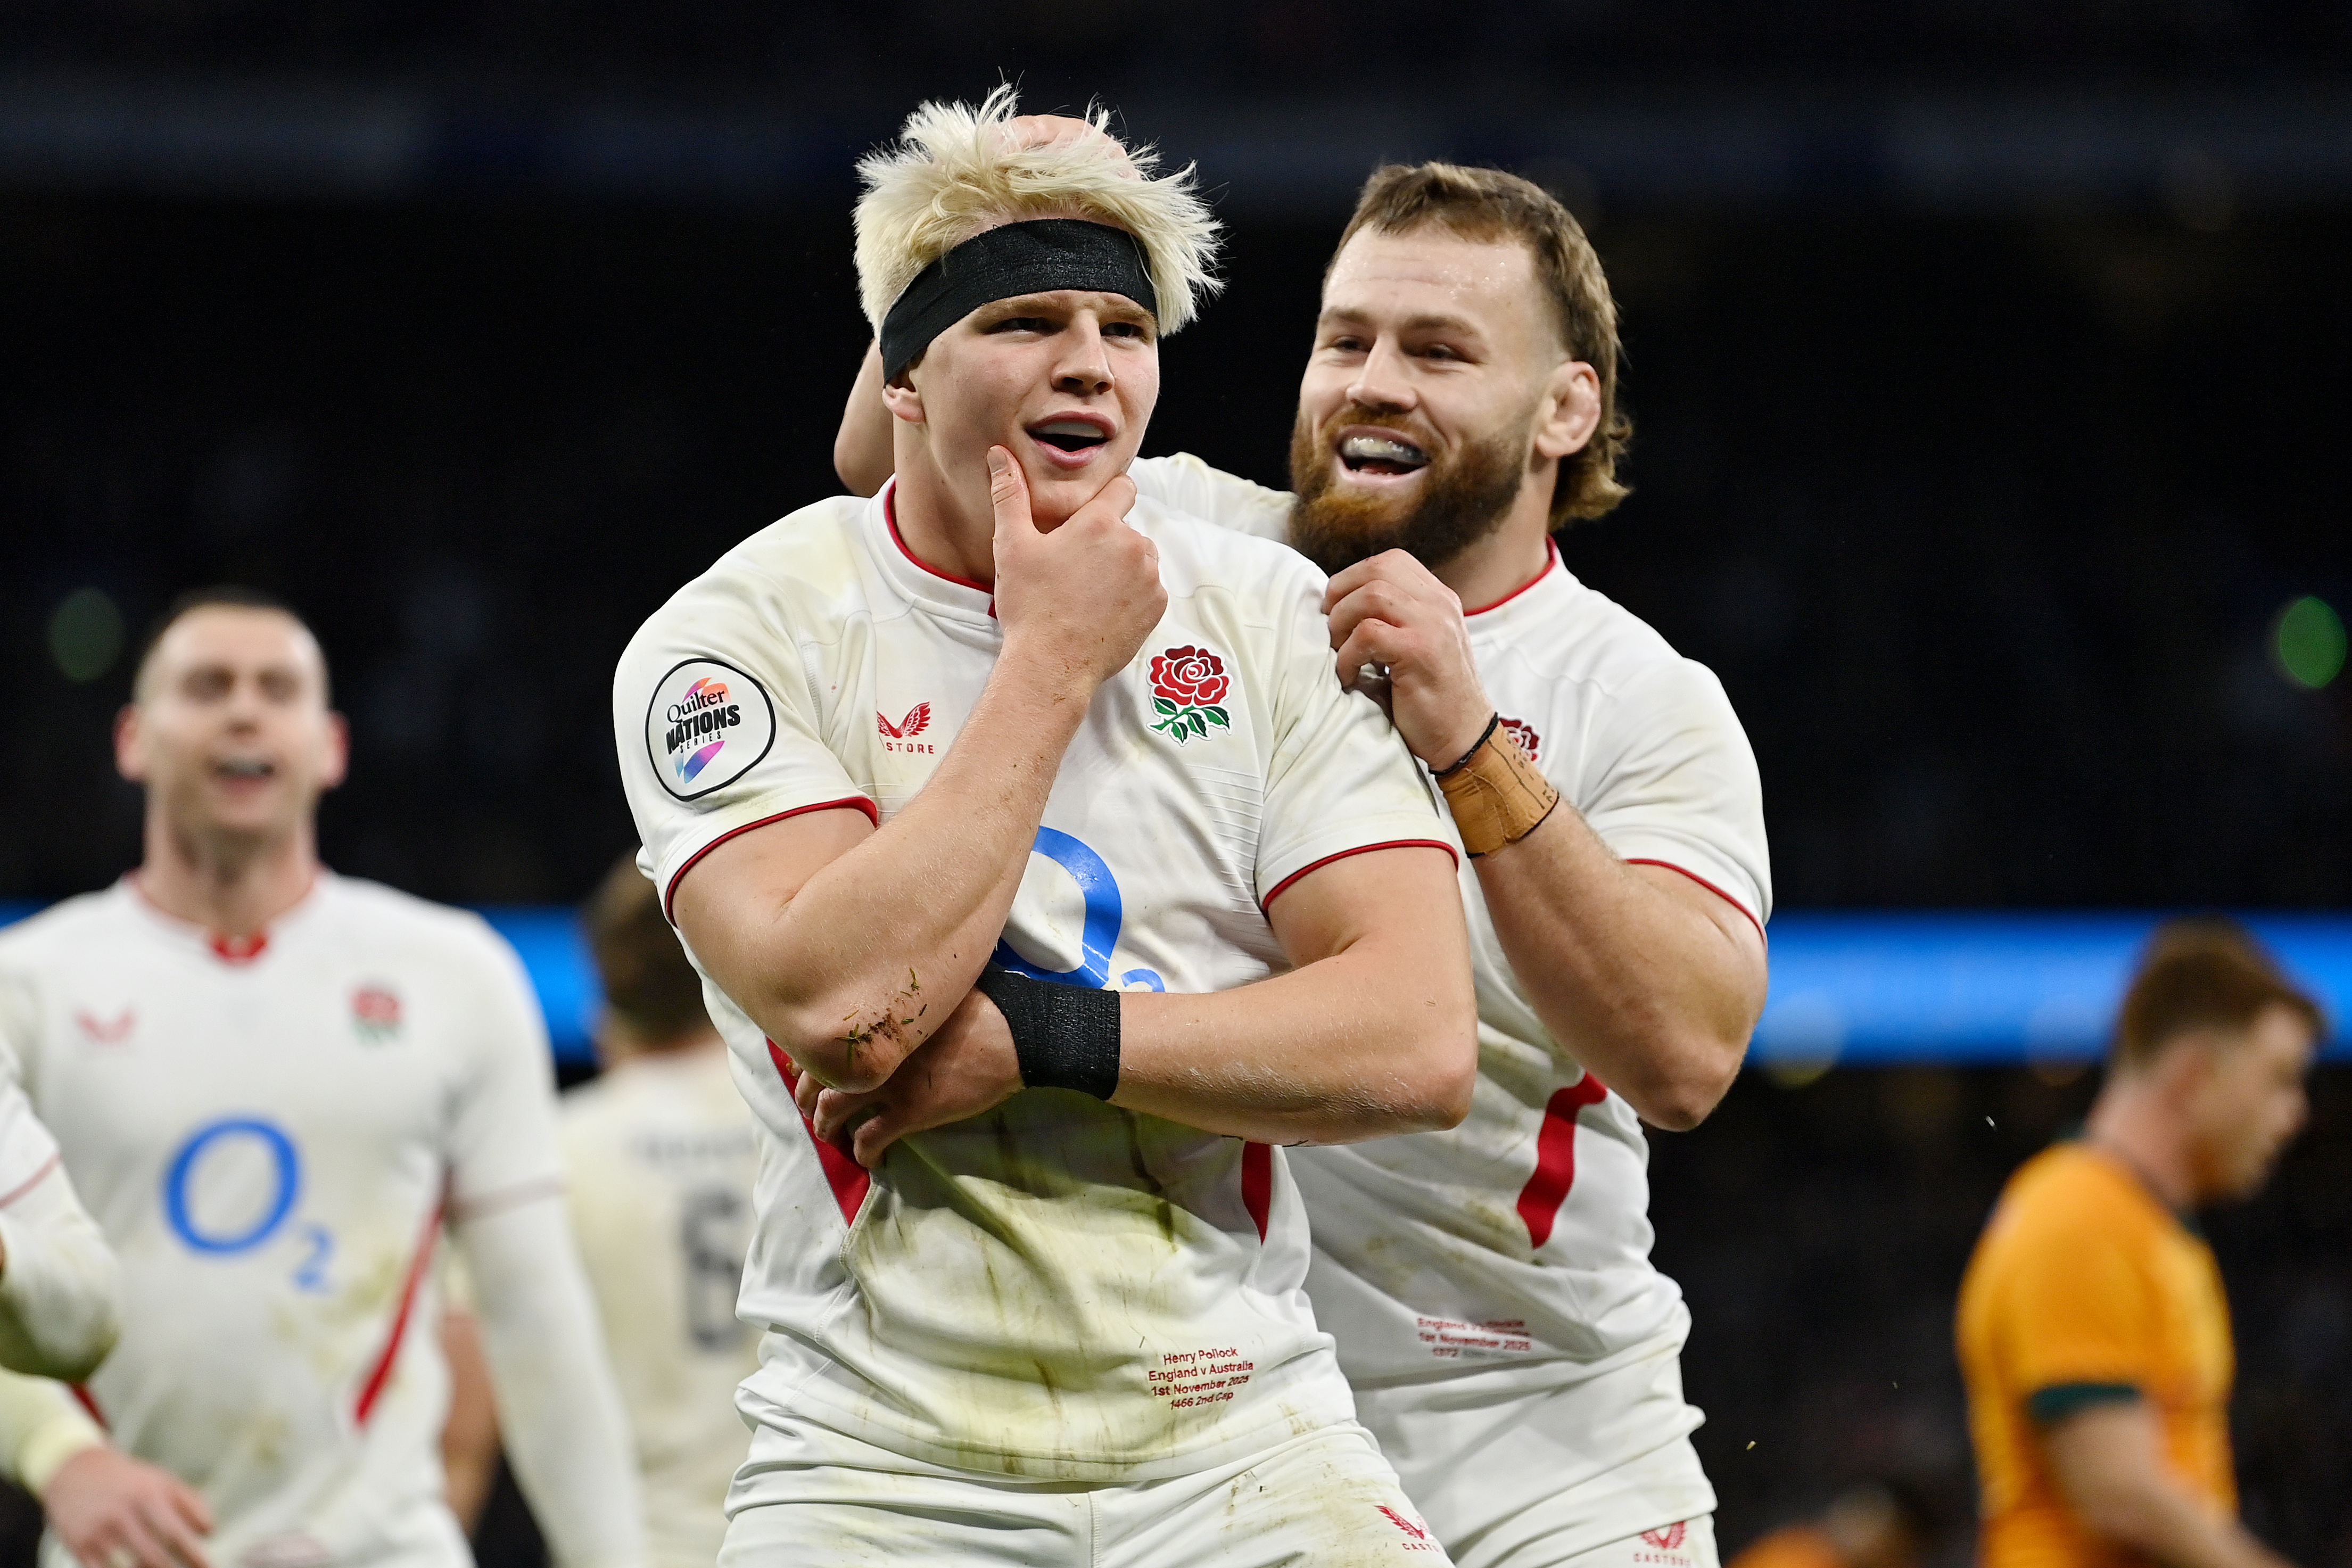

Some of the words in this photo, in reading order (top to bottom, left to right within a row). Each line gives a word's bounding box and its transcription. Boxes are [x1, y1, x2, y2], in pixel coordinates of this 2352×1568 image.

[667, 690, 725, 723] Quilter
[666, 705, 740, 755] NATIONS
[680, 731, 721, 753] SERIES
[886, 742, 934, 754] STORE
[163, 1115, 333, 1296] O2
[1164, 1352, 1195, 1365] Henry
[1199, 1347, 1239, 1360] Pollock
[1149, 1366, 1198, 1382] England
[1209, 1360, 1253, 1374] Australia
[1152, 1386, 1170, 1396] 1st
[1174, 1380, 1226, 1394] November
[1227, 1375, 1250, 1387] 2025
[1170, 1398, 1194, 1410] 1466
[1195, 1393, 1214, 1406] 2nd
[1215, 1392, 1234, 1401] Cap
